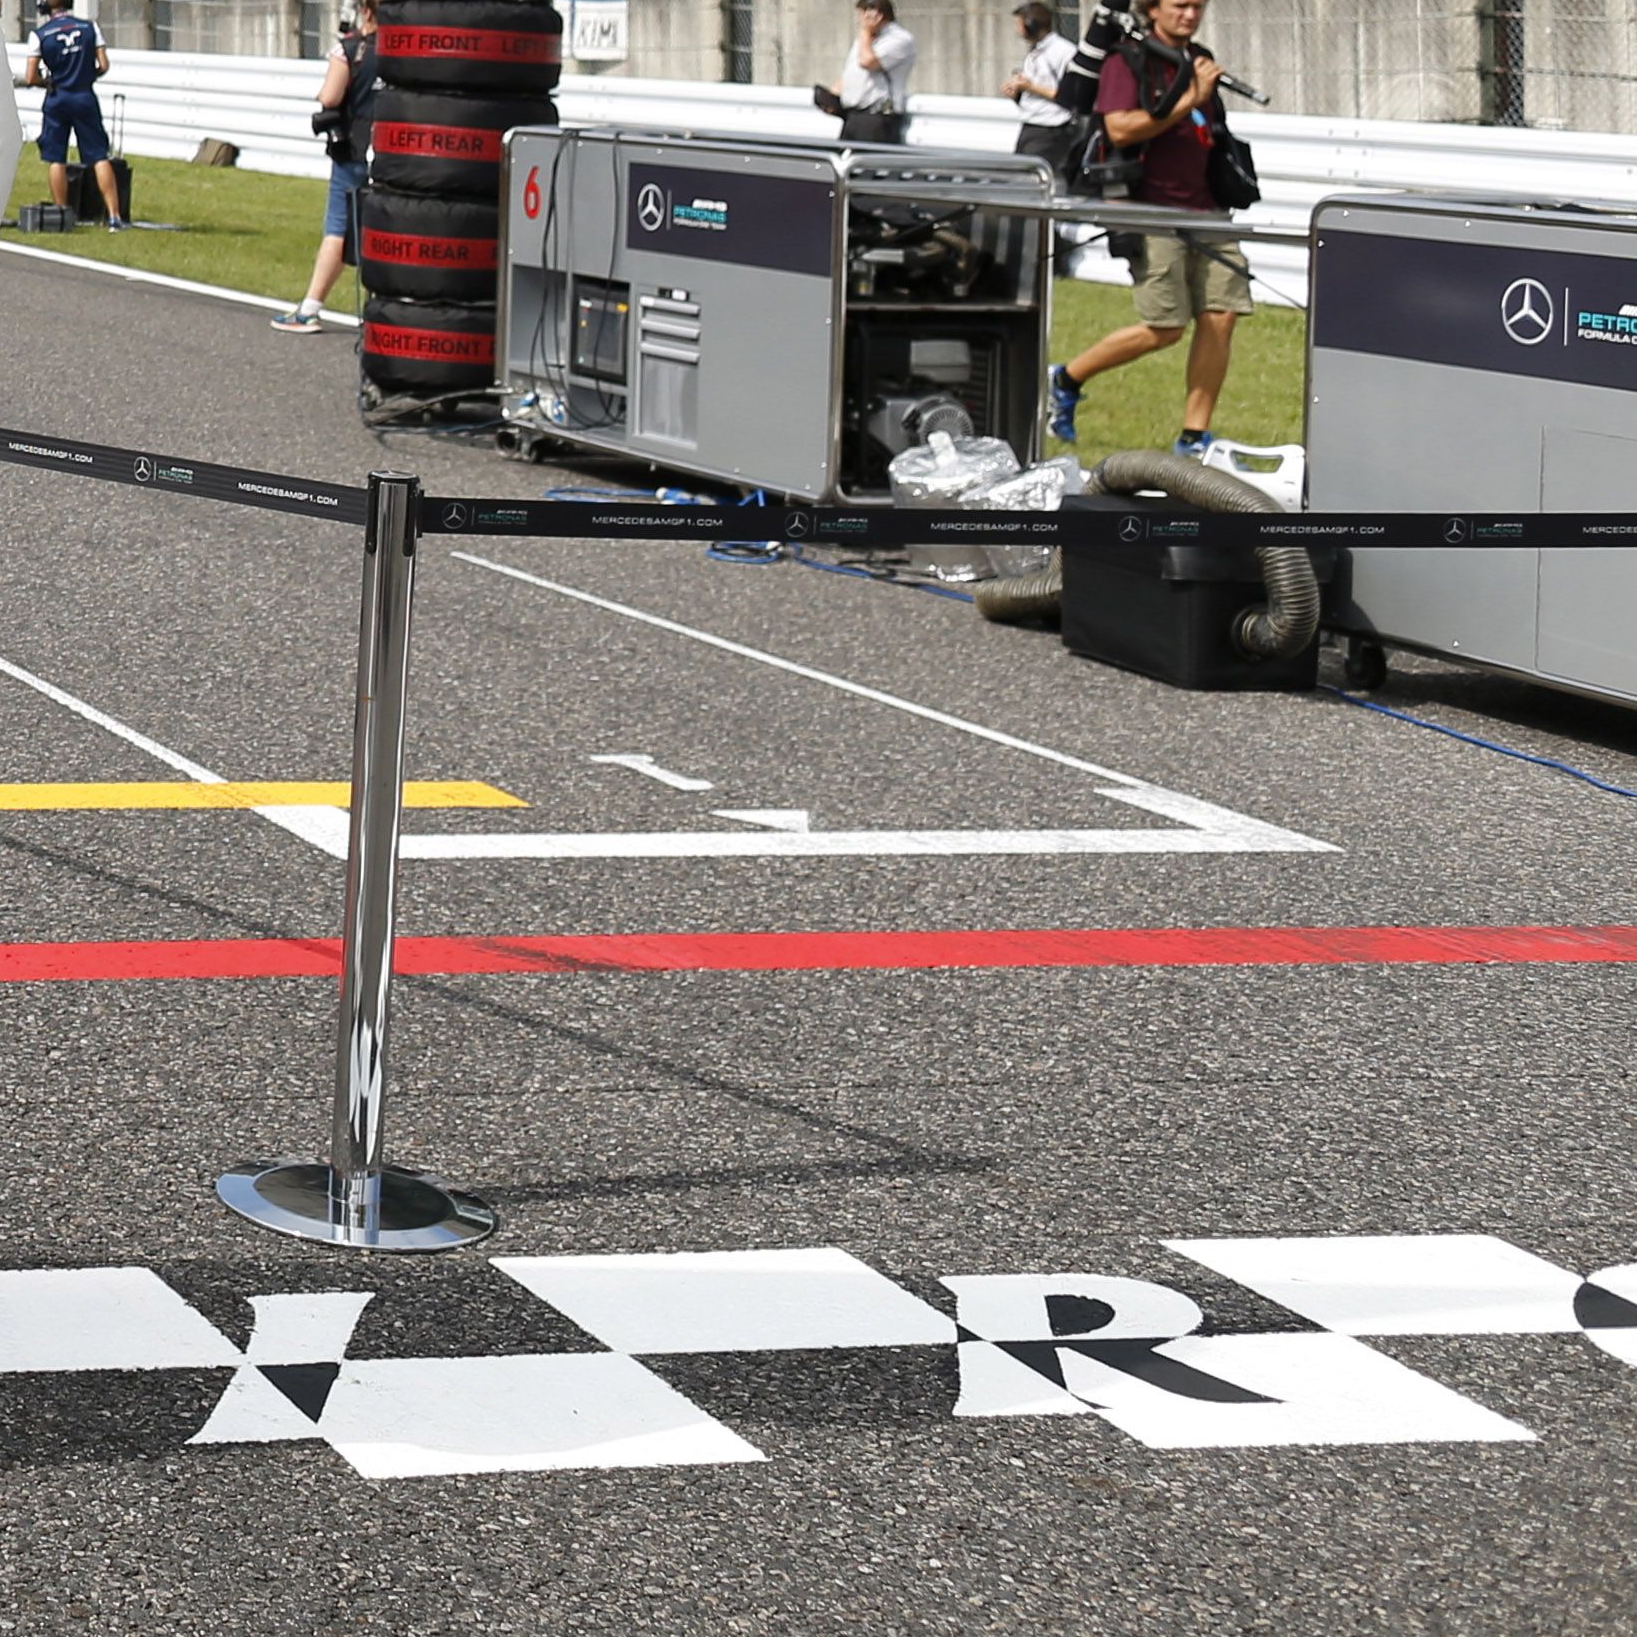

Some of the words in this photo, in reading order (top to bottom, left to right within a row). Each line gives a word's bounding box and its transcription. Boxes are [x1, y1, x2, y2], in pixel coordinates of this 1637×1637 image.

[384, 33, 415, 50] LEFT
[418, 34, 482, 52] FRONT
[389, 130, 426, 149] LEFT
[431, 132, 484, 152] REAR
[524, 166, 542, 220] 6
[371, 237, 415, 257] RIGHT
[418, 240, 470, 260] REAR
[417, 334, 483, 356] FRONT
